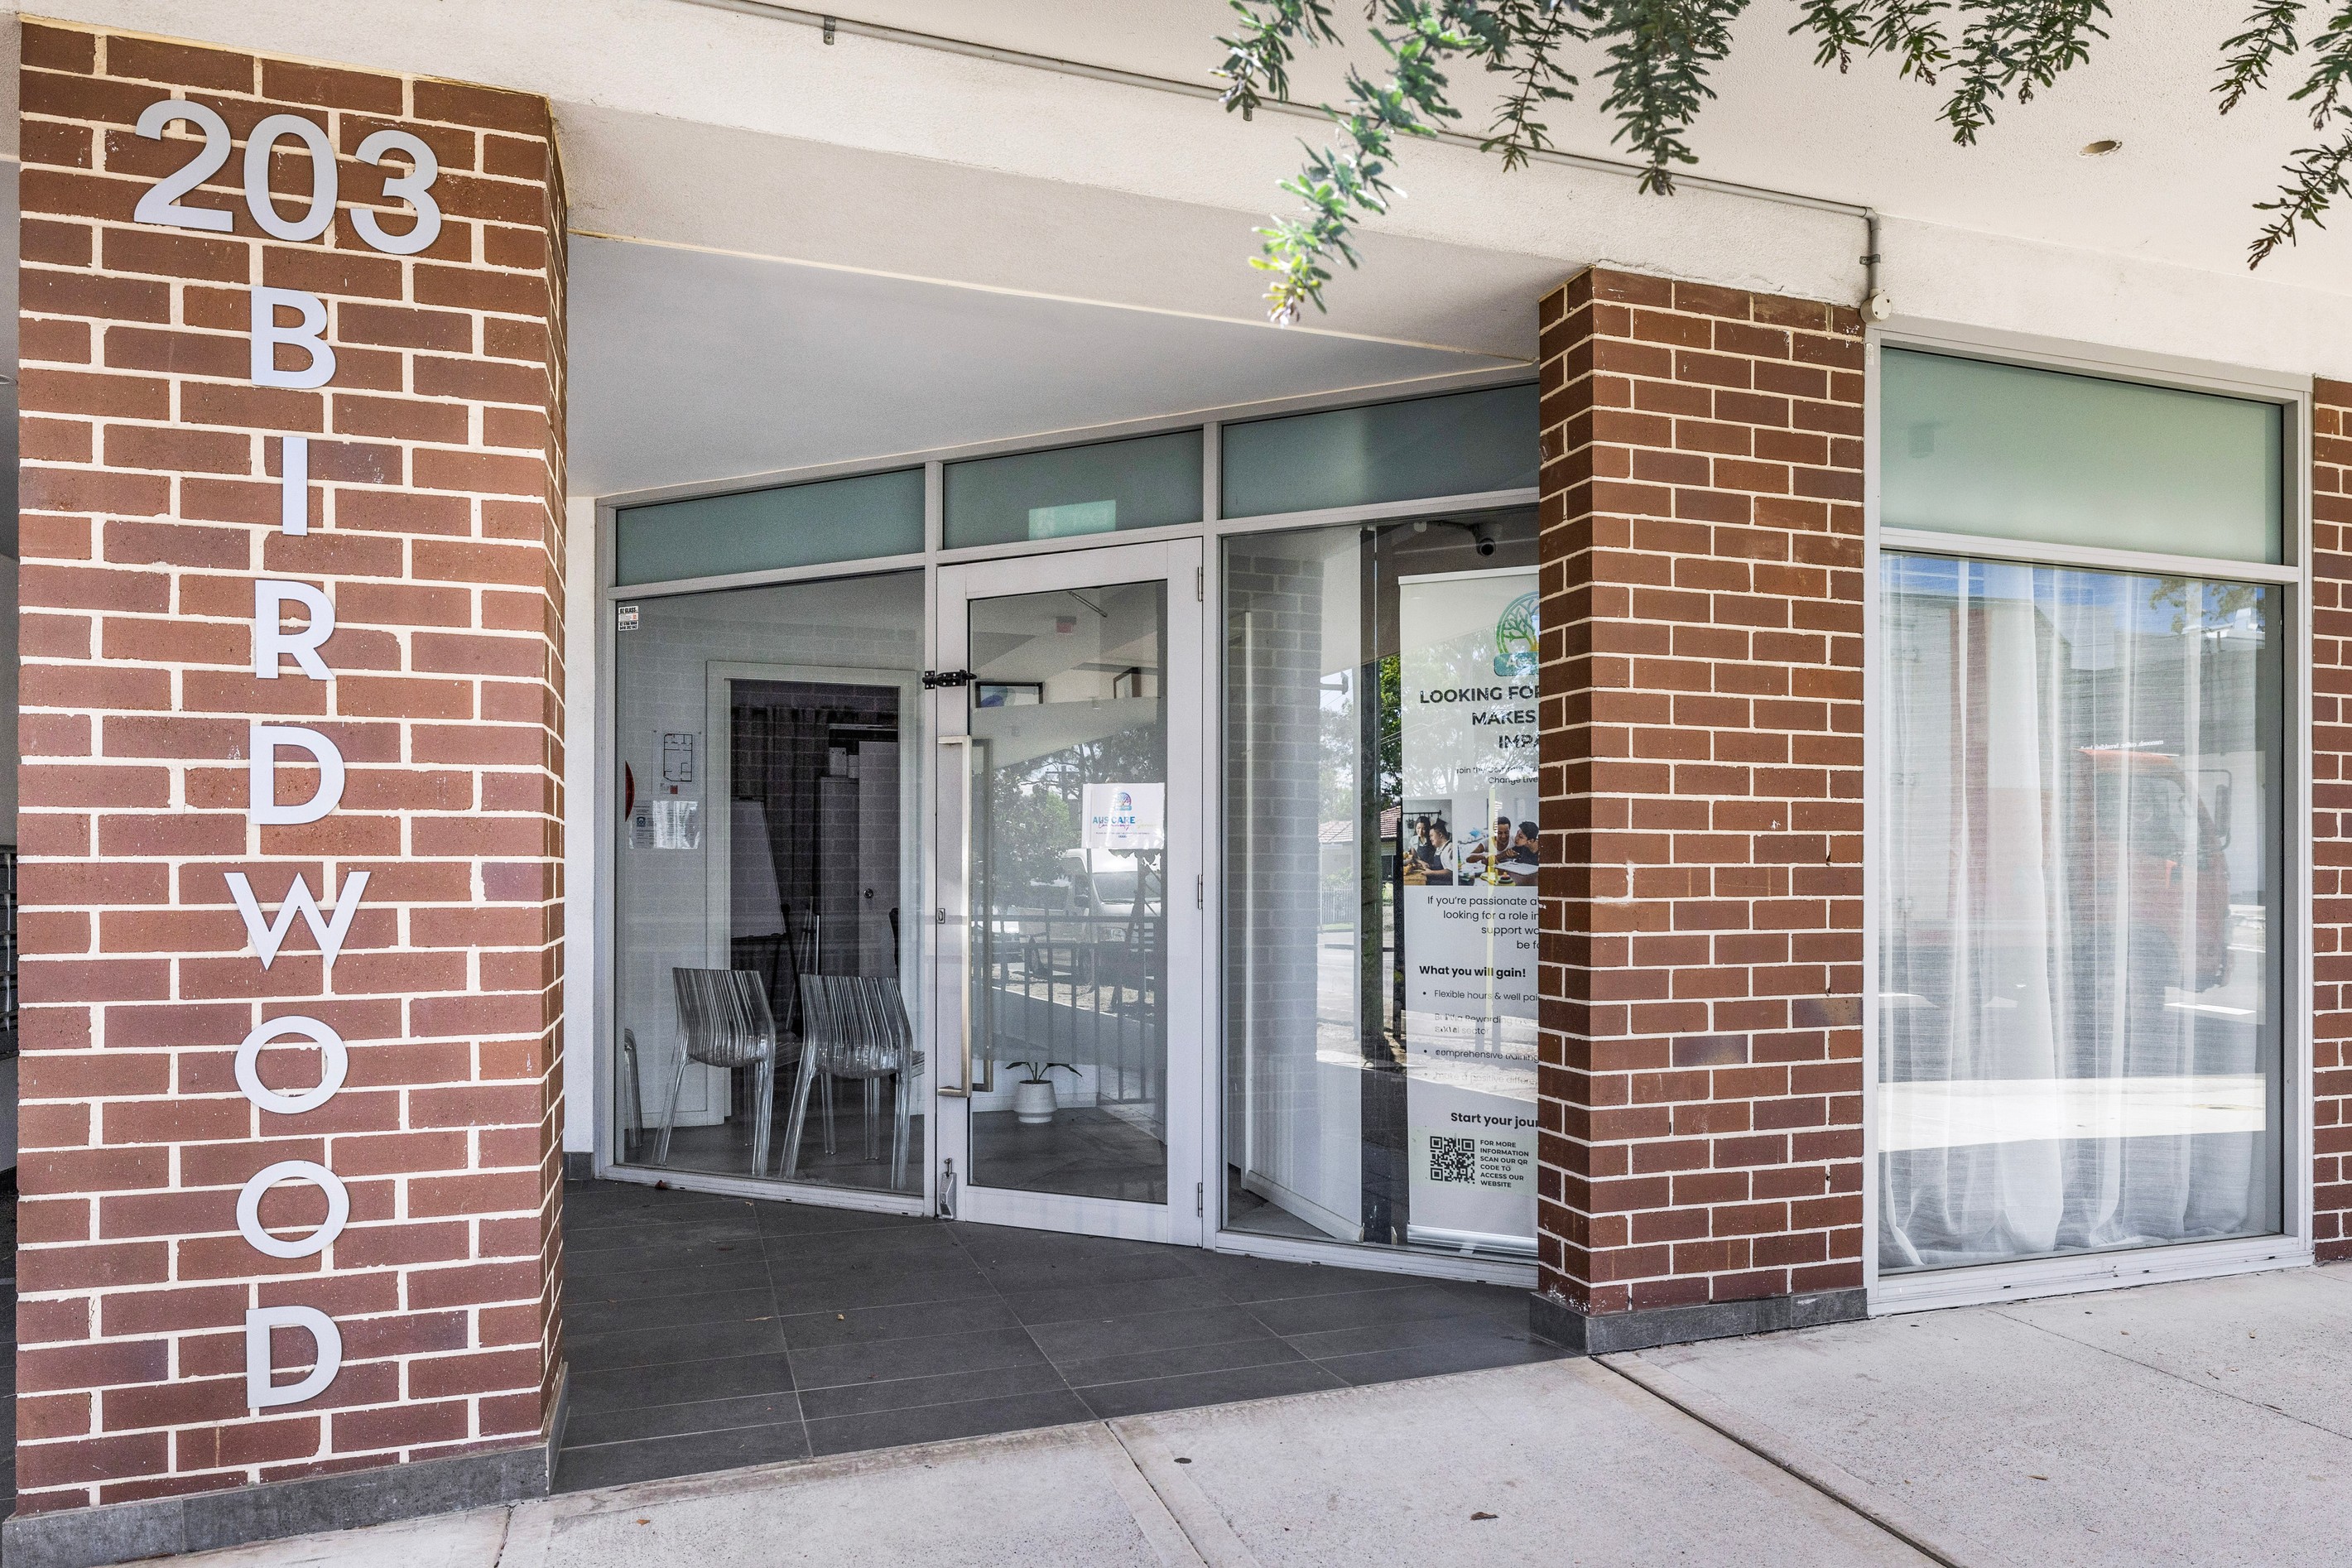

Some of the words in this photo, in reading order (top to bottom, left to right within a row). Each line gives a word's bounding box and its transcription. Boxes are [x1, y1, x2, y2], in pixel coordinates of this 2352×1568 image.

[132, 99, 443, 257] 203
[1420, 687, 1502, 703] LOOKING
[1472, 709, 1537, 725] MAKES
[1427, 896, 1434, 904] If
[1469, 897, 1527, 907] passionate
[1443, 910, 1479, 922] looking
[1482, 911, 1496, 920] for
[1508, 911, 1529, 921] role
[1481, 926, 1522, 936] support
[1517, 940, 1530, 950] be
[1419, 965, 1450, 975] What
[1452, 968, 1472, 978] you
[1474, 966, 1494, 977] will
[1496, 967, 1526, 979] gain!
[1434, 990, 1465, 998] Flexible
[1467, 991, 1492, 999] hours
[1503, 993, 1521, 1001] well
[1436, 1050, 1503, 1060] comprehensive
[1450, 1112, 1481, 1123] Start
[1484, 1116, 1513, 1127] your
[1480, 1148, 1529, 1157] INFORMATION
